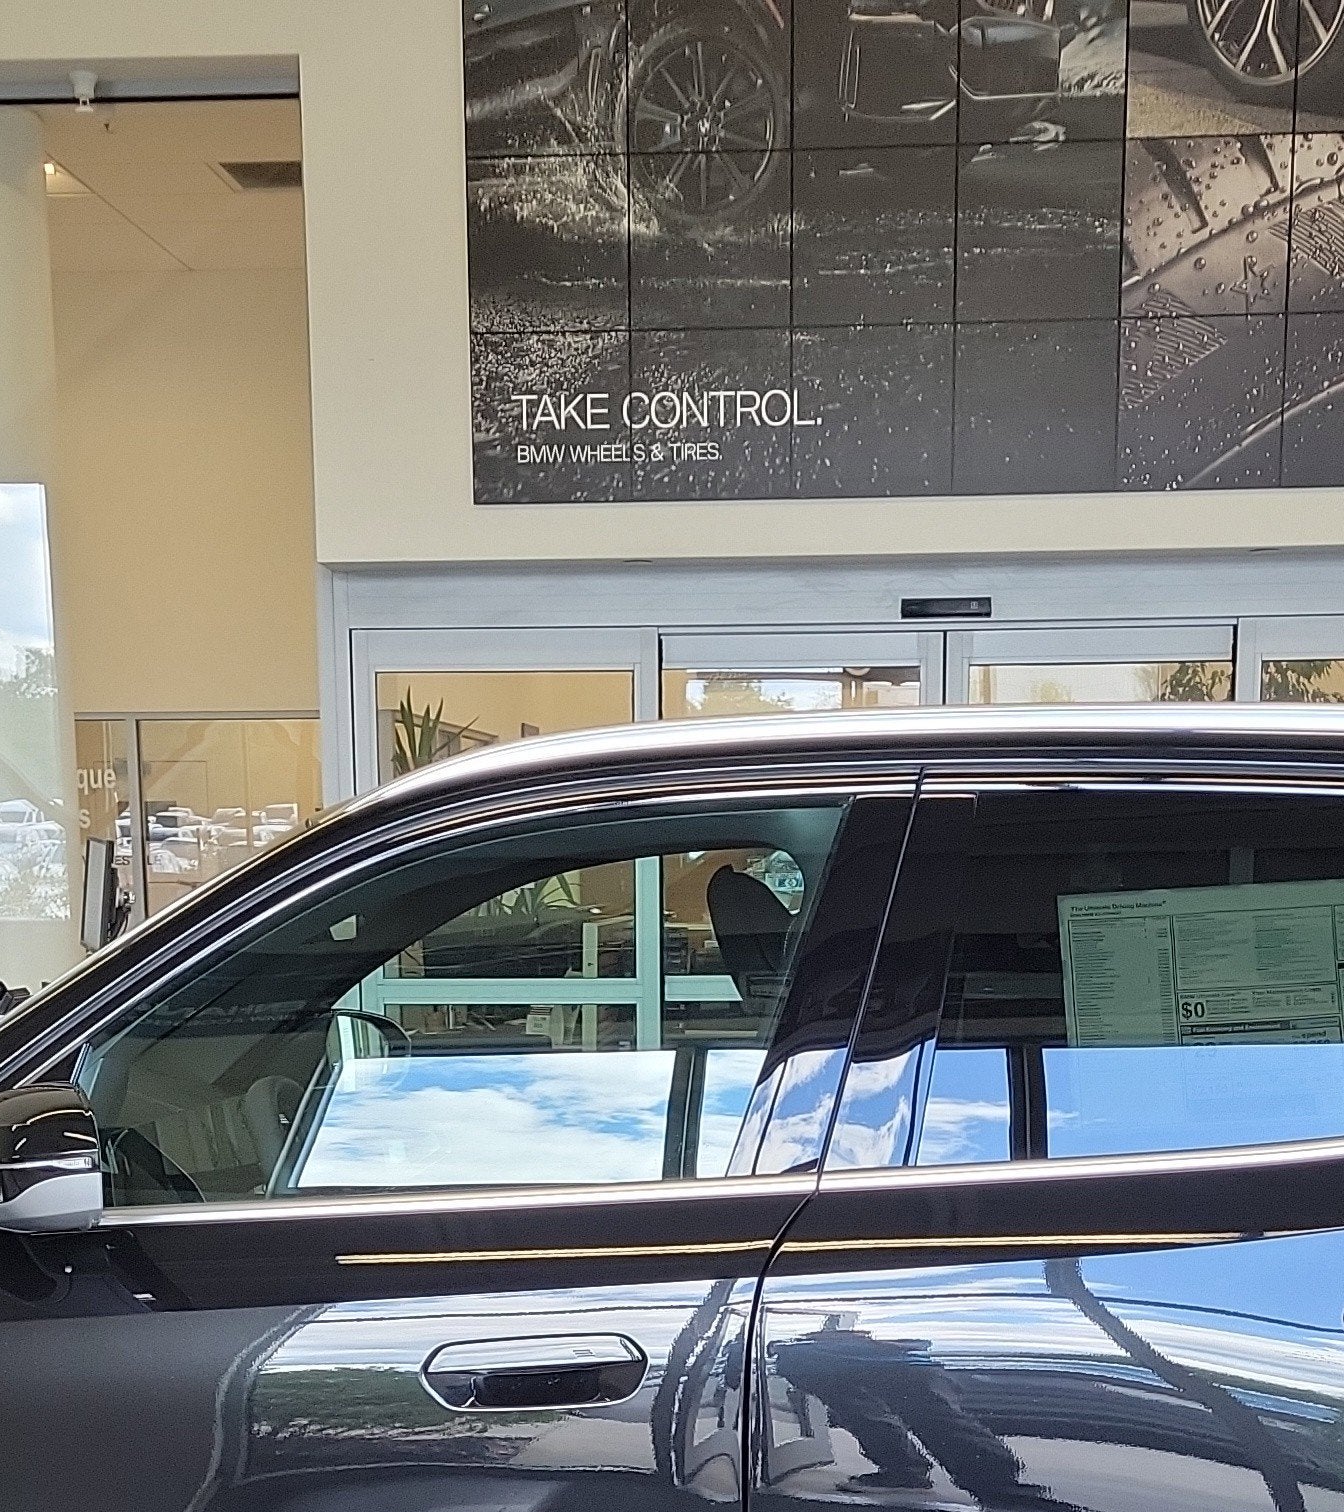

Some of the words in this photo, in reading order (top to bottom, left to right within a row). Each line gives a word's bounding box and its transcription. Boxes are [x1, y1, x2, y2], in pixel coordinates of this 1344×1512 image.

[510, 392, 611, 431] TAKE
[622, 389, 823, 429] CONTROL.
[517, 444, 565, 464] BMW
[568, 443, 645, 463] WHEELS
[650, 443, 664, 462] &
[669, 441, 723, 461] TIRES.
[1181, 1001, 1205, 1020] $0
